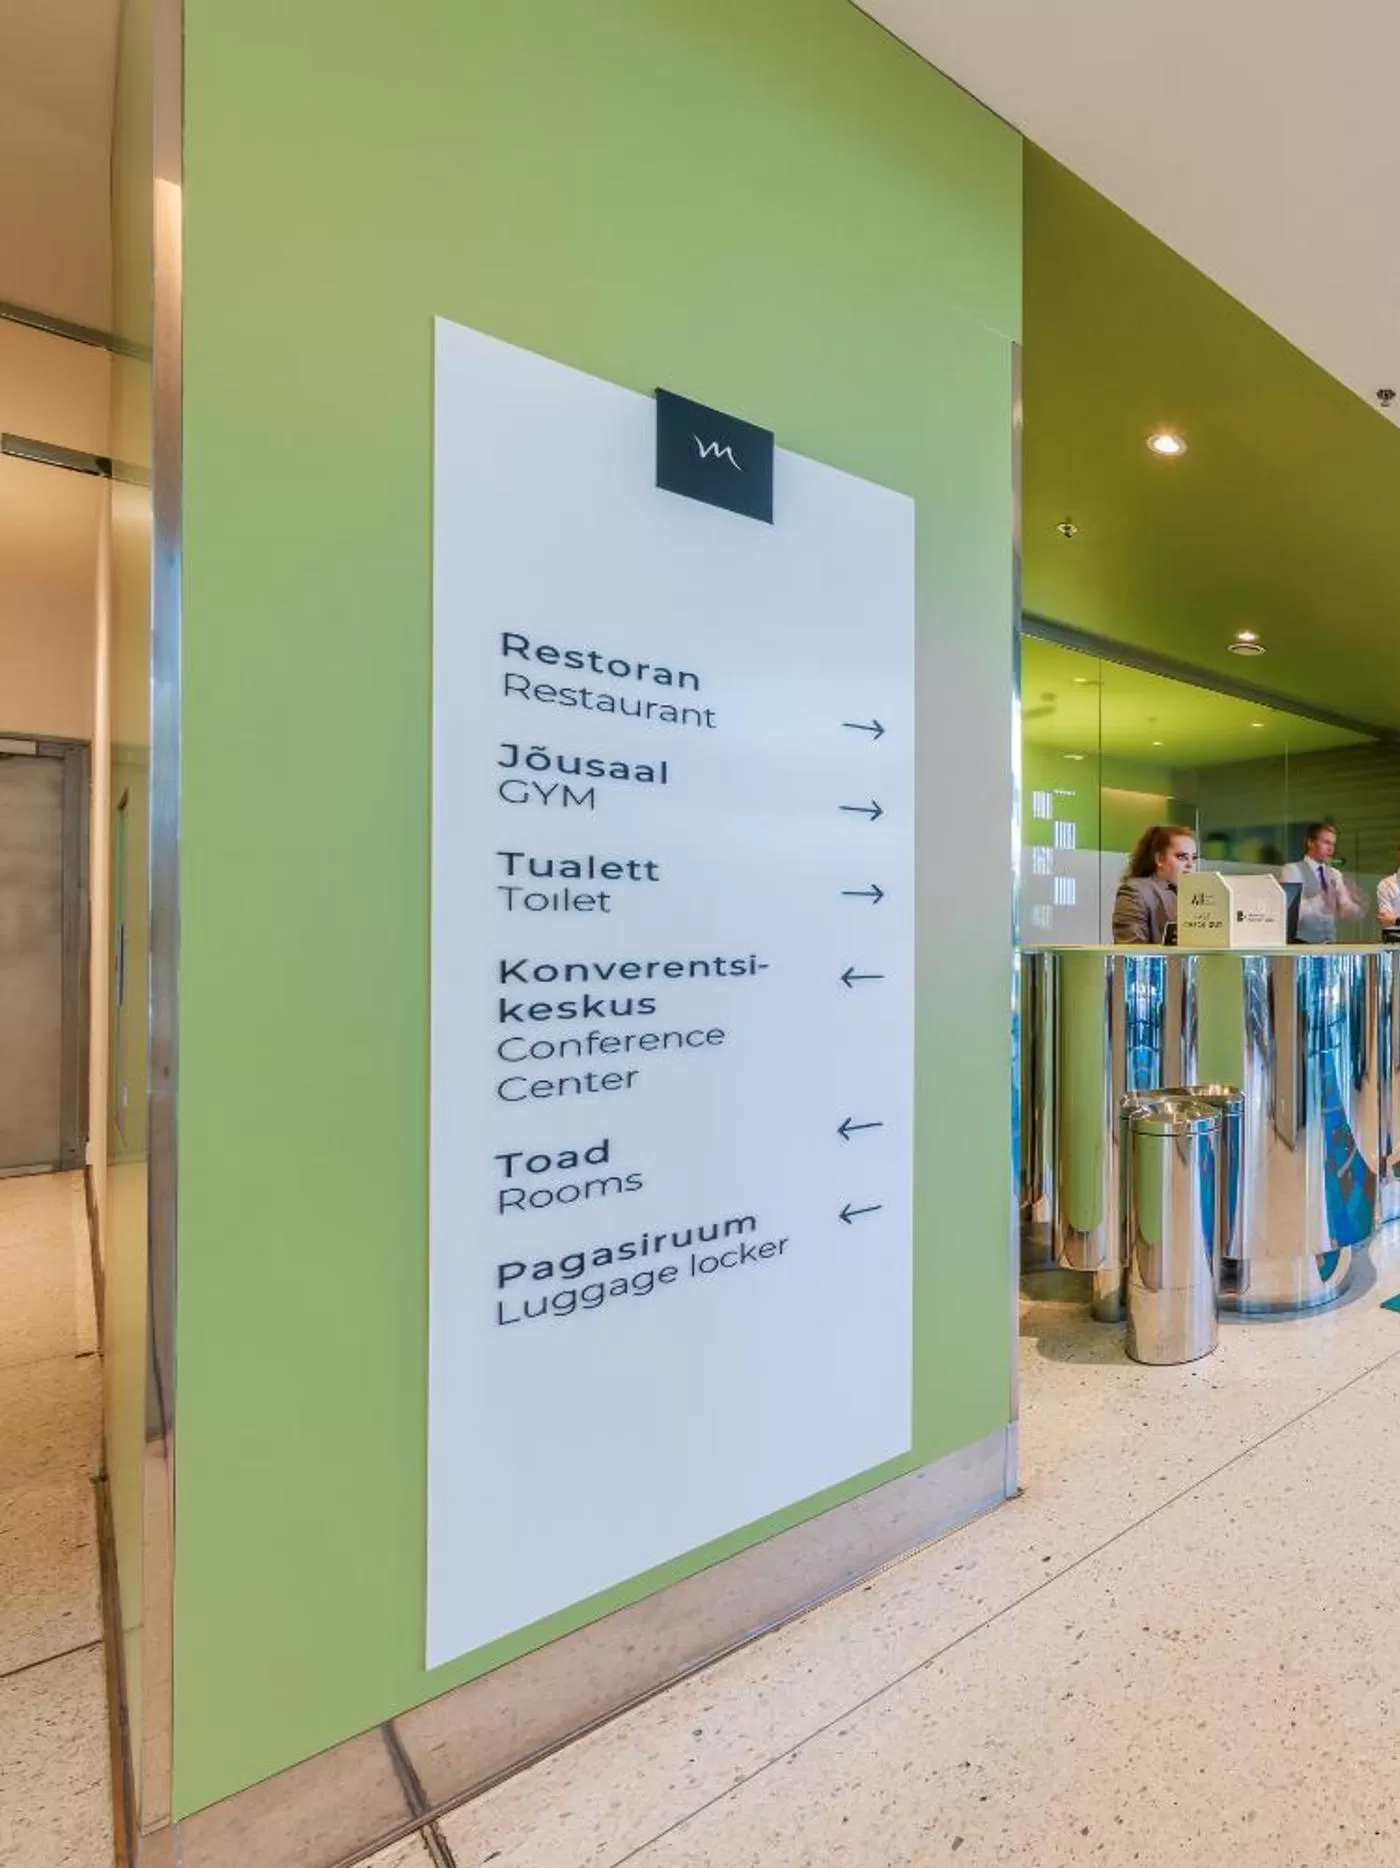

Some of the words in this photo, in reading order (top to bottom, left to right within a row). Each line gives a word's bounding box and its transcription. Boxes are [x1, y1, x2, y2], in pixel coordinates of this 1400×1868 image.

[500, 631, 701, 692] Restoran
[503, 671, 718, 729] Restaurant
[497, 742, 668, 785] Jõusaal
[498, 779, 596, 811] GYM
[495, 850, 661, 882] Tualett
[498, 953, 770, 985] Konverentsi-
[498, 993, 657, 1025] keskus
[496, 1026, 726, 1064] Conference
[496, 1069, 640, 1102] Center
[493, 1137, 610, 1179] Toad
[498, 1172, 645, 1216] Rooms
[496, 1212, 758, 1290] Pagasiruum
[495, 1265, 679, 1327] Luggage
[690, 1236, 789, 1279] locker
